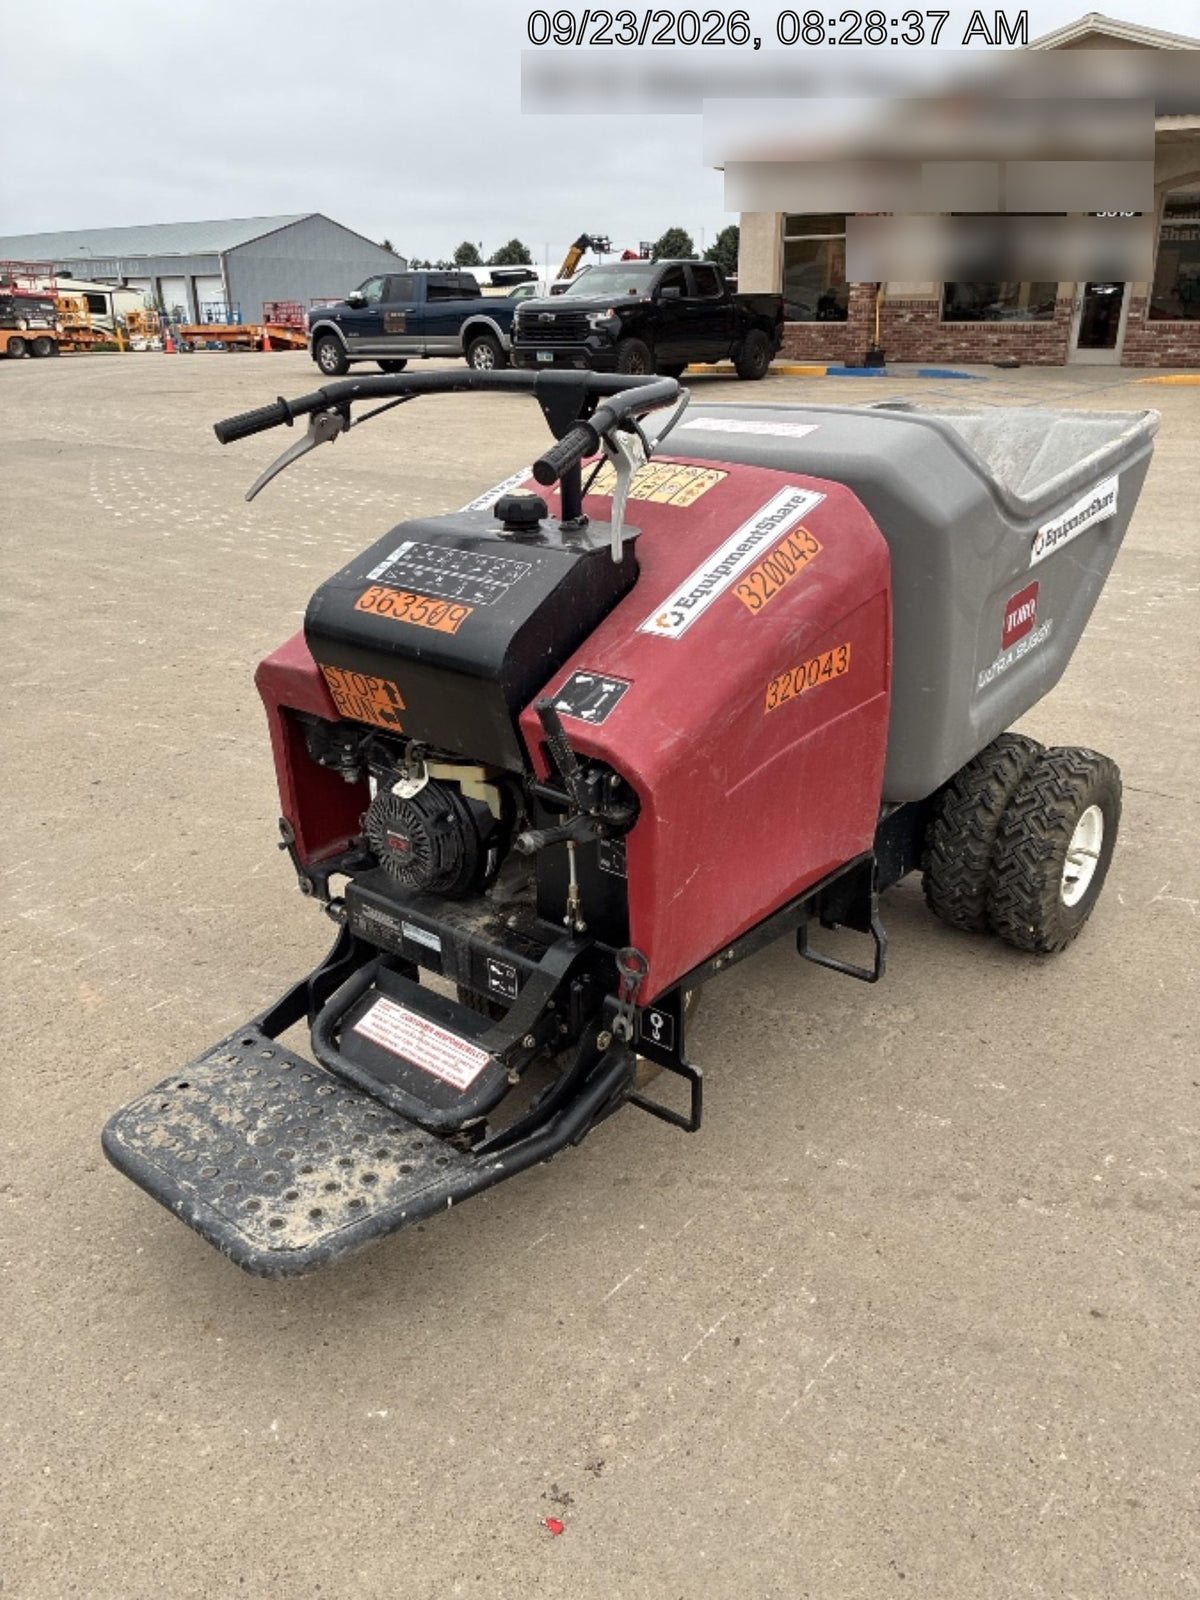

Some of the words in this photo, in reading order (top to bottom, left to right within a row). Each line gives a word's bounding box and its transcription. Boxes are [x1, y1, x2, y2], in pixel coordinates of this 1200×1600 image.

[1043, 490, 1115, 548] EquipmentShare
[679, 494, 808, 609] EquipmentShare
[737, 528, 821, 610] 320043
[359, 587, 469, 632] 363509
[1006, 598, 1036, 633] TORO
[323, 666, 380, 697] STOP
[767, 645, 850, 710] 320043
[332, 690, 380, 722] RUN
